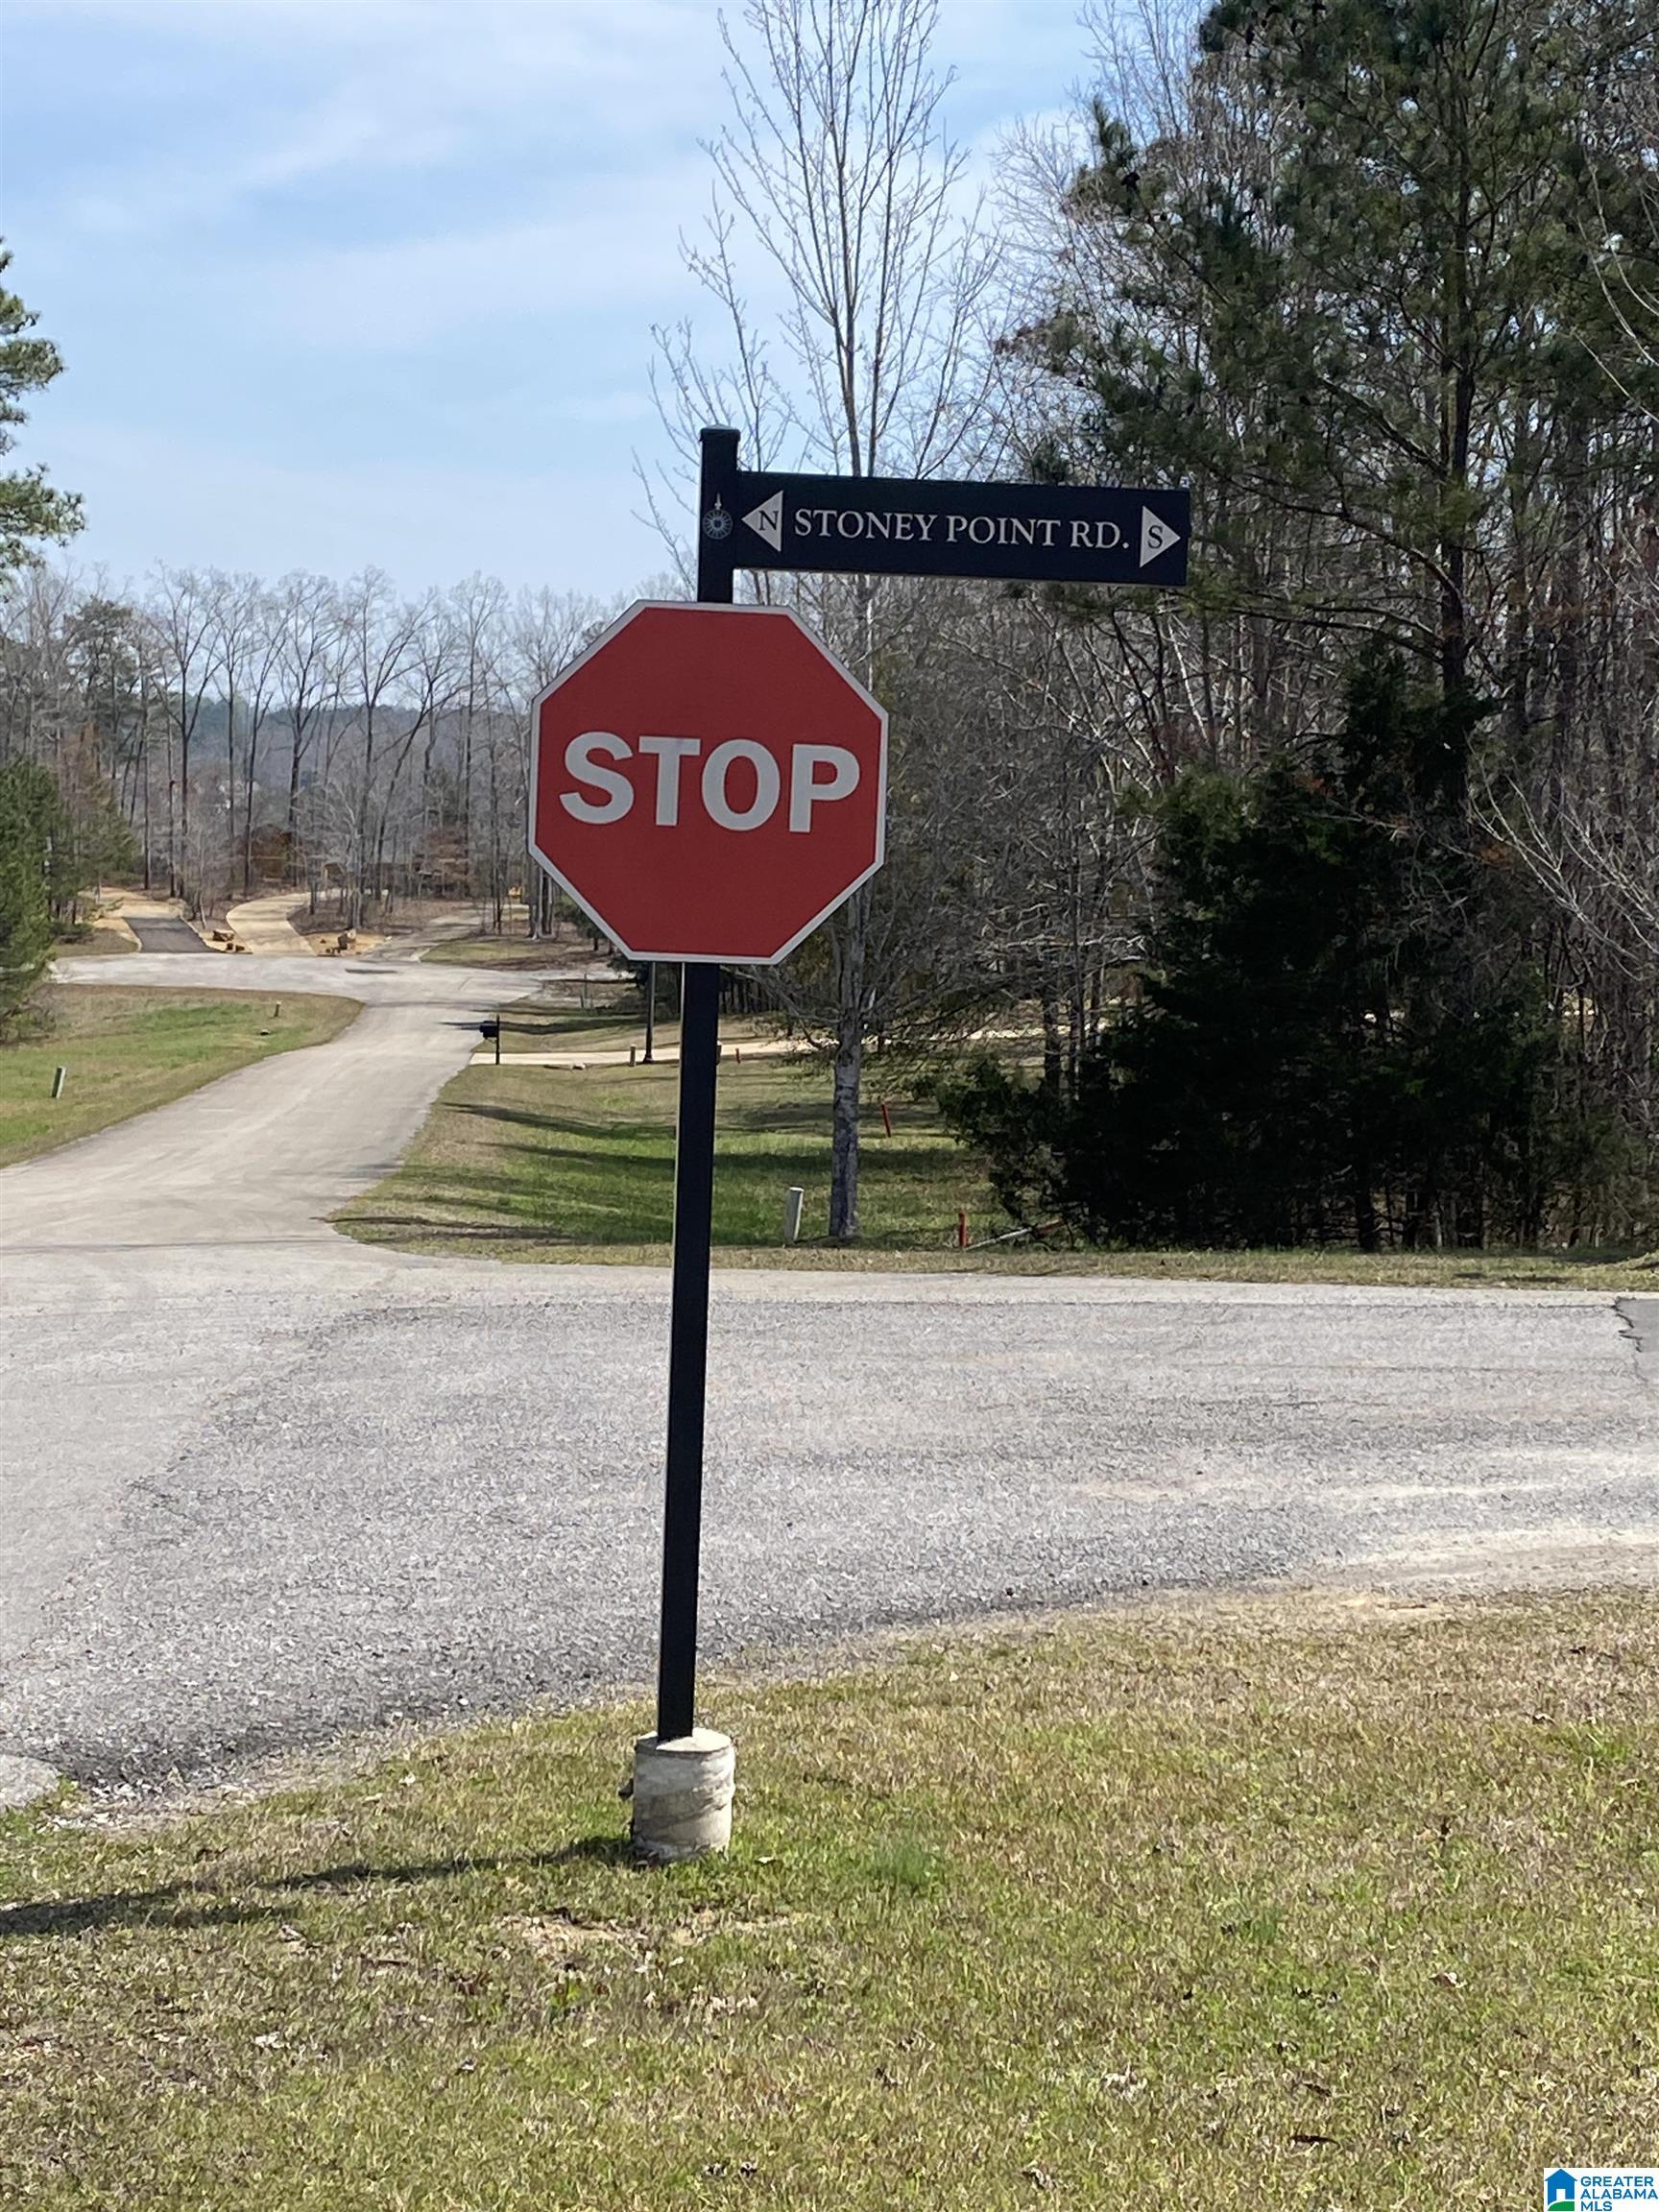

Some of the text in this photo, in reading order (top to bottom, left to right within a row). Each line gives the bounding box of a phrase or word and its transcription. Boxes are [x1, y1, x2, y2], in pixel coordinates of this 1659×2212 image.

[758, 508, 1164, 550] N STONEY POINT RD. S
[559, 731, 860, 833] STOP
